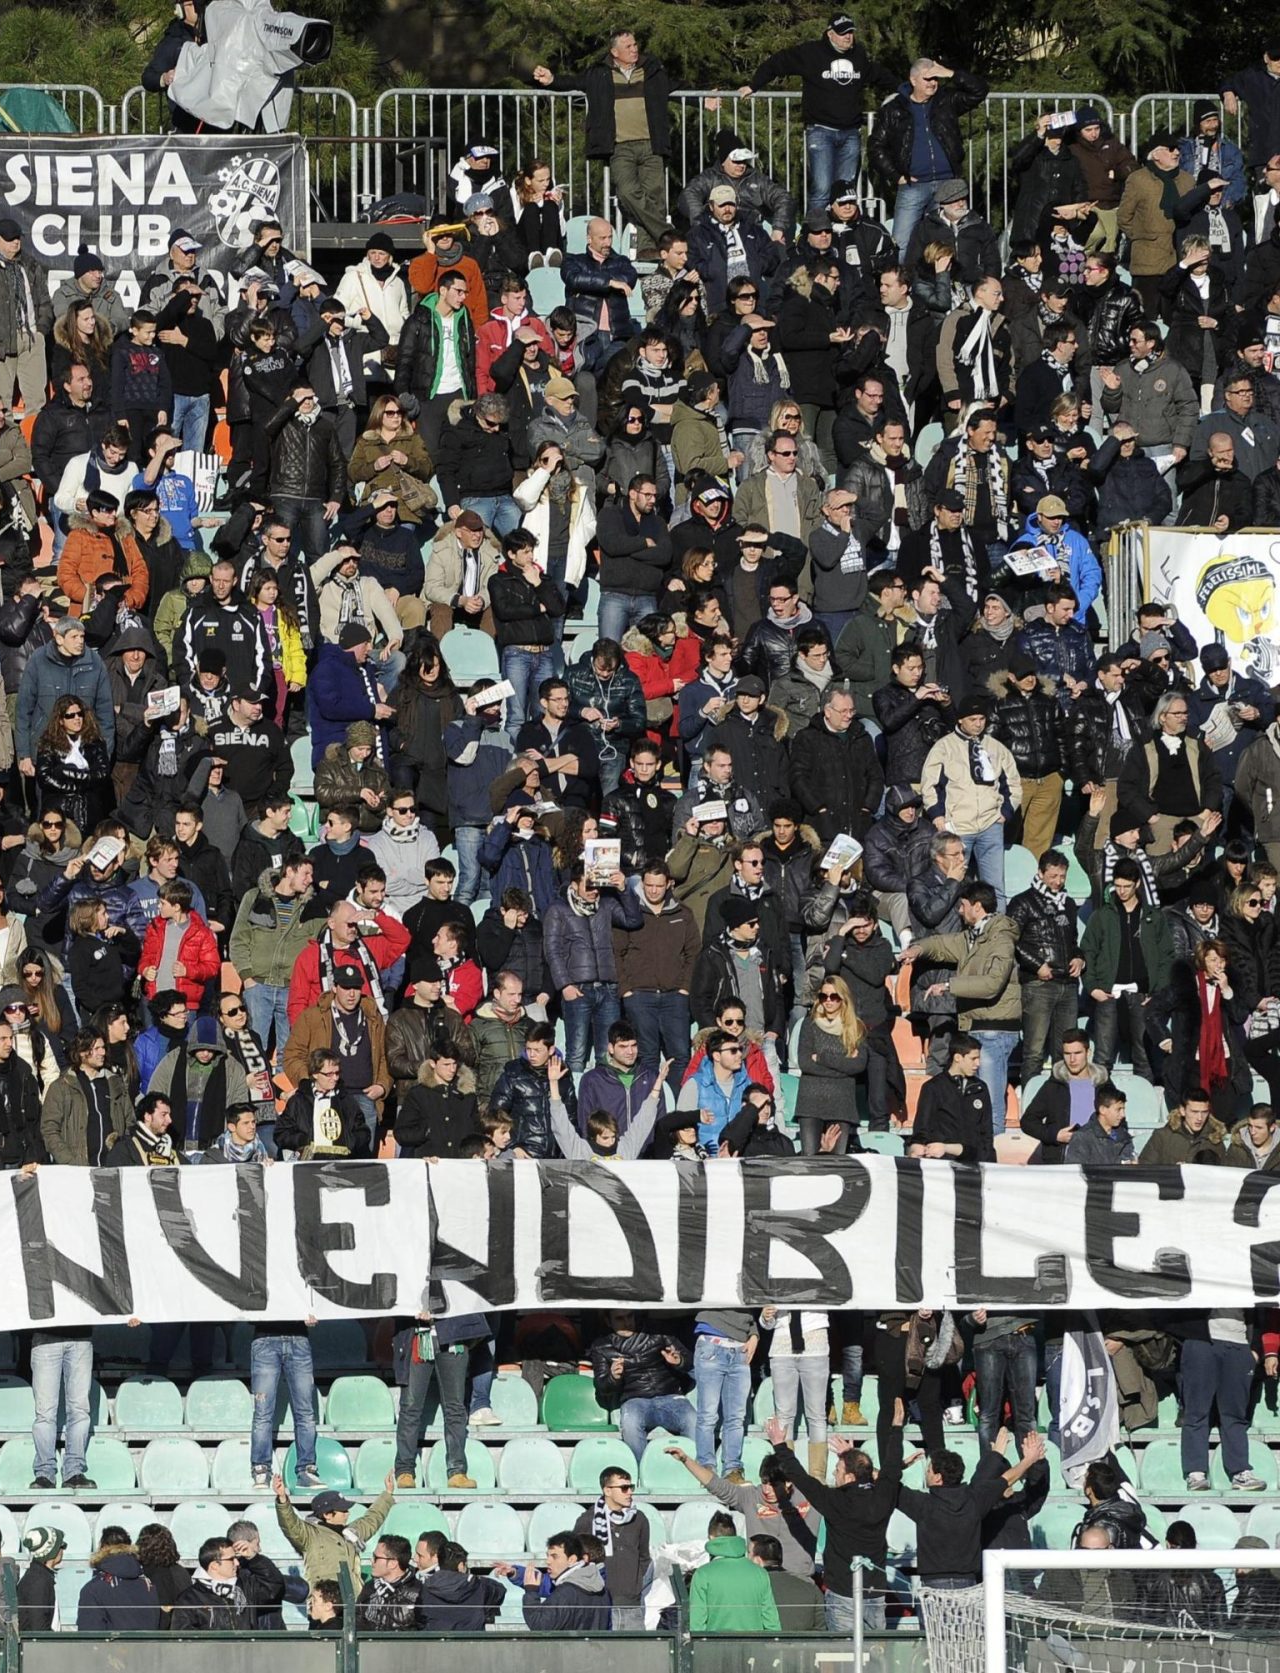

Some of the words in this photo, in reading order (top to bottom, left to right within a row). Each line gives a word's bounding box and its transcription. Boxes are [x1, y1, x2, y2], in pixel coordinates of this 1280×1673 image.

[4, 152, 198, 206] SIENA
[251, 183, 277, 206] SIENA
[31, 213, 172, 257] CLUB
[1199, 562, 1261, 601] FEDELISSIMI
[214, 731, 270, 748] SIENA
